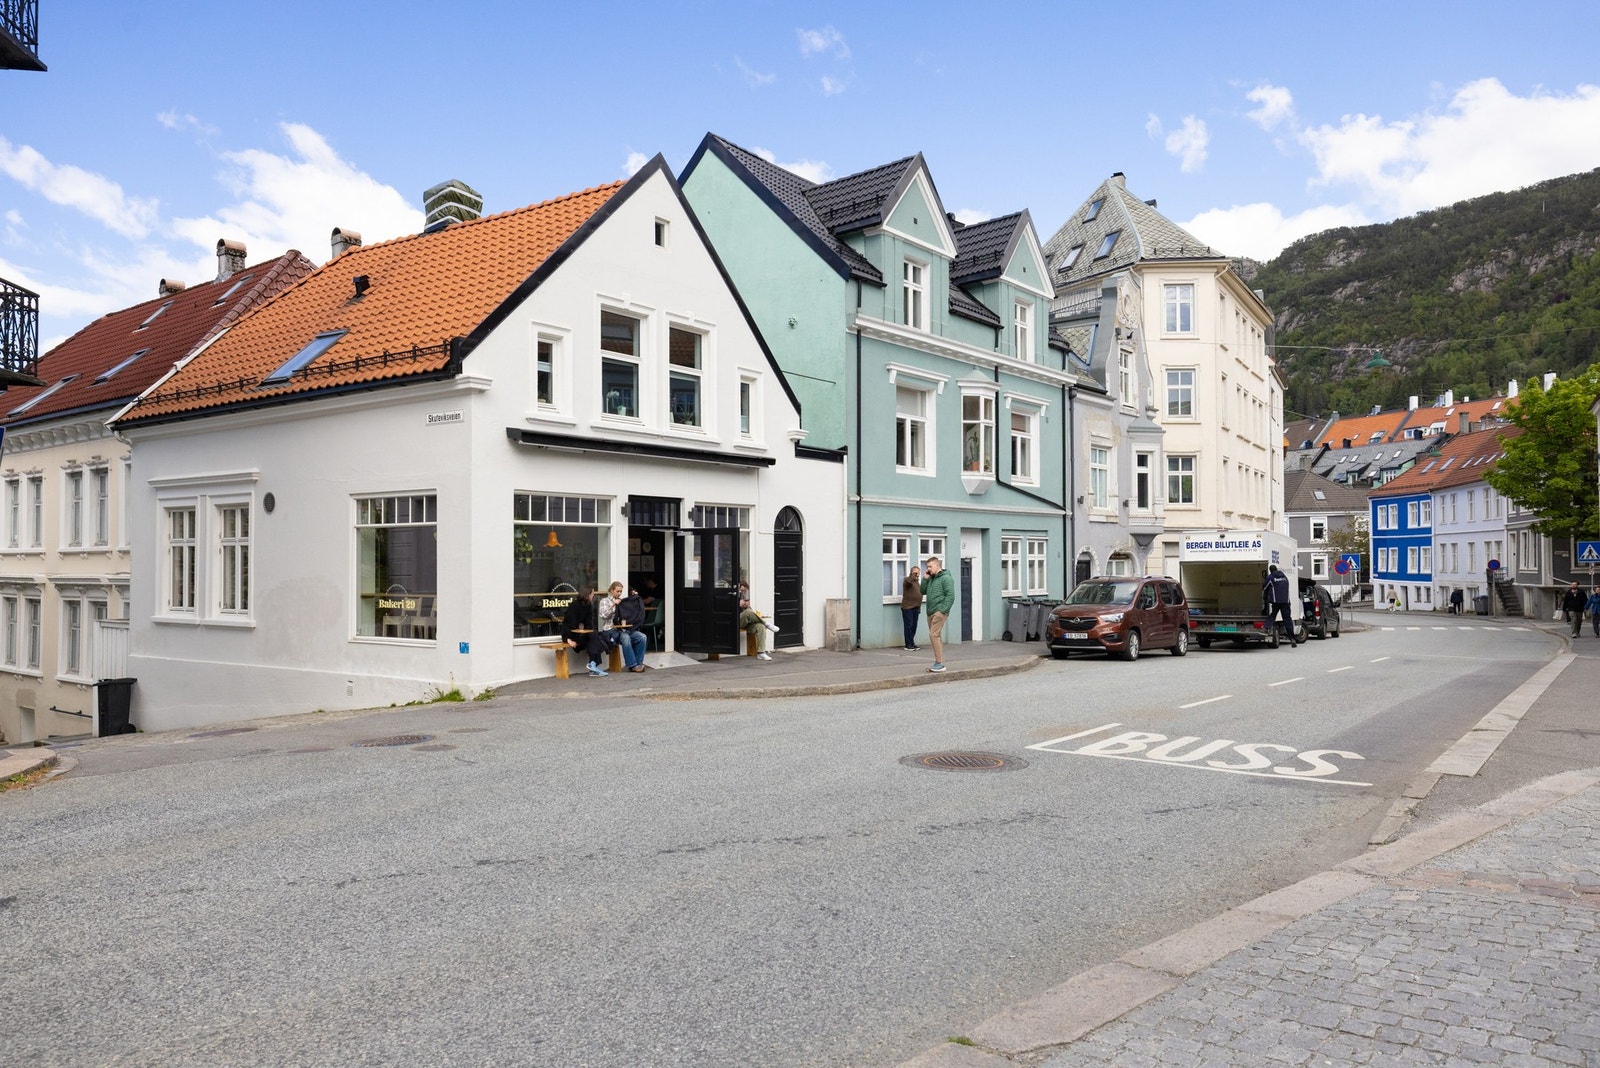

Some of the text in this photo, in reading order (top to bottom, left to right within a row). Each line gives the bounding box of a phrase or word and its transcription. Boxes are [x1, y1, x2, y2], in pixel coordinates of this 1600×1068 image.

[428, 411, 461, 423] Skuteviksveien
[1186, 540, 1262, 549] BERGEN BILUTLEIE AS
[378, 599, 416, 609] Bakeri 29
[1075, 731, 1366, 776] BUSS
